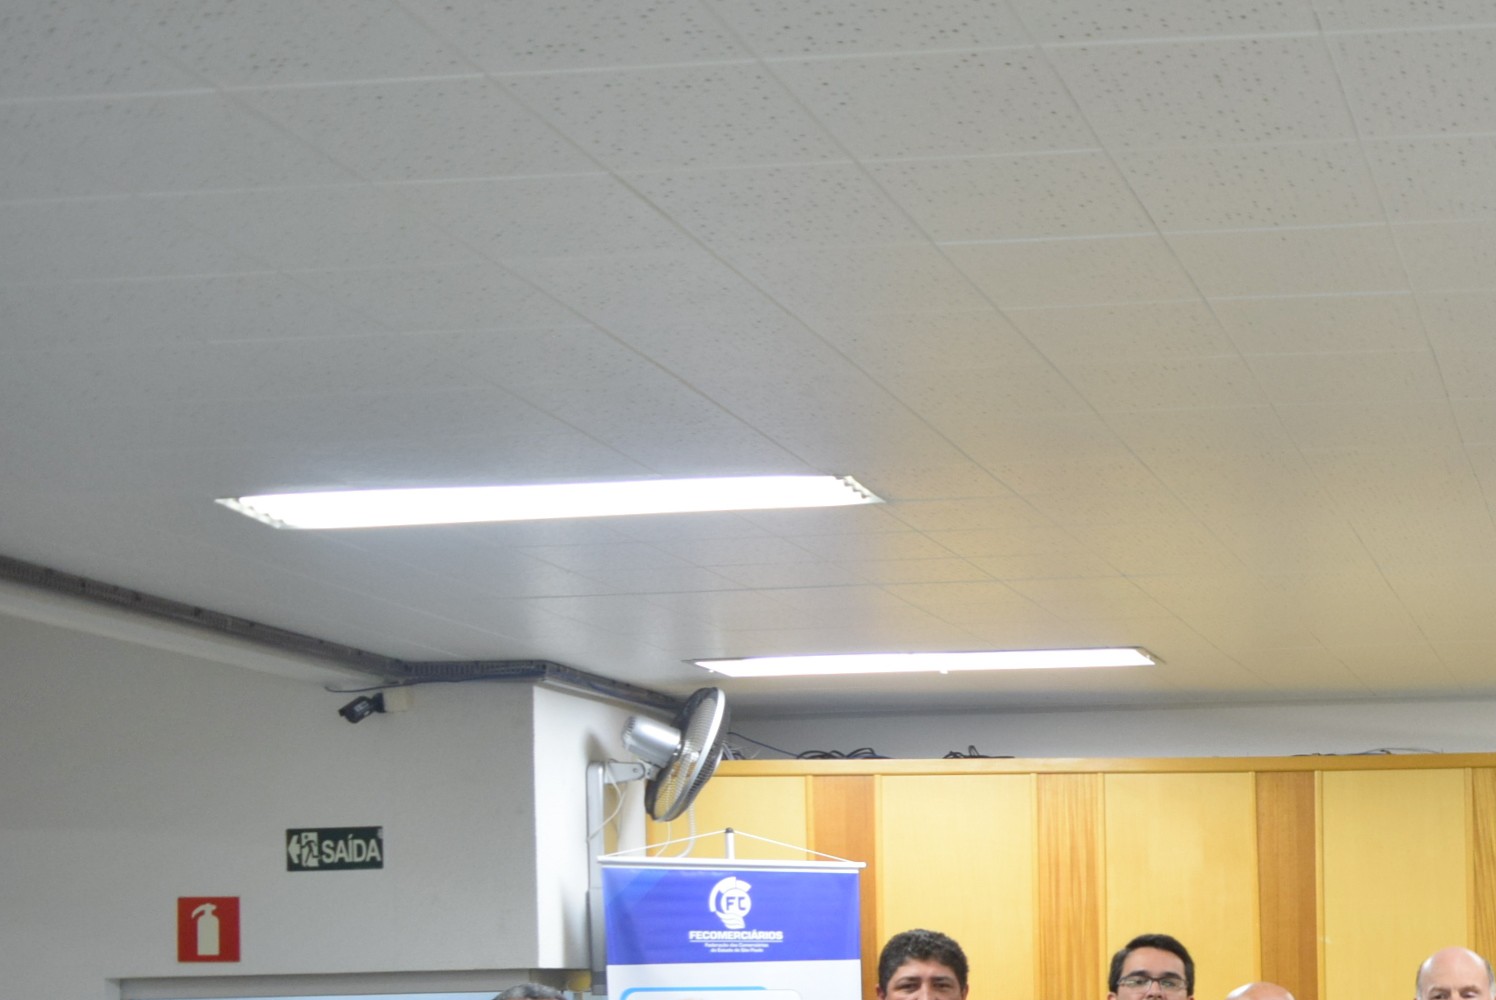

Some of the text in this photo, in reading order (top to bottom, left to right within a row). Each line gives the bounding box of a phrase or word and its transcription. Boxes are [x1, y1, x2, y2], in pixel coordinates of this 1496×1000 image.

[321, 833, 381, 863] SAÍDA
[726, 896, 746, 911] FC
[689, 929, 784, 940] FECOMERCIÁRIOS
